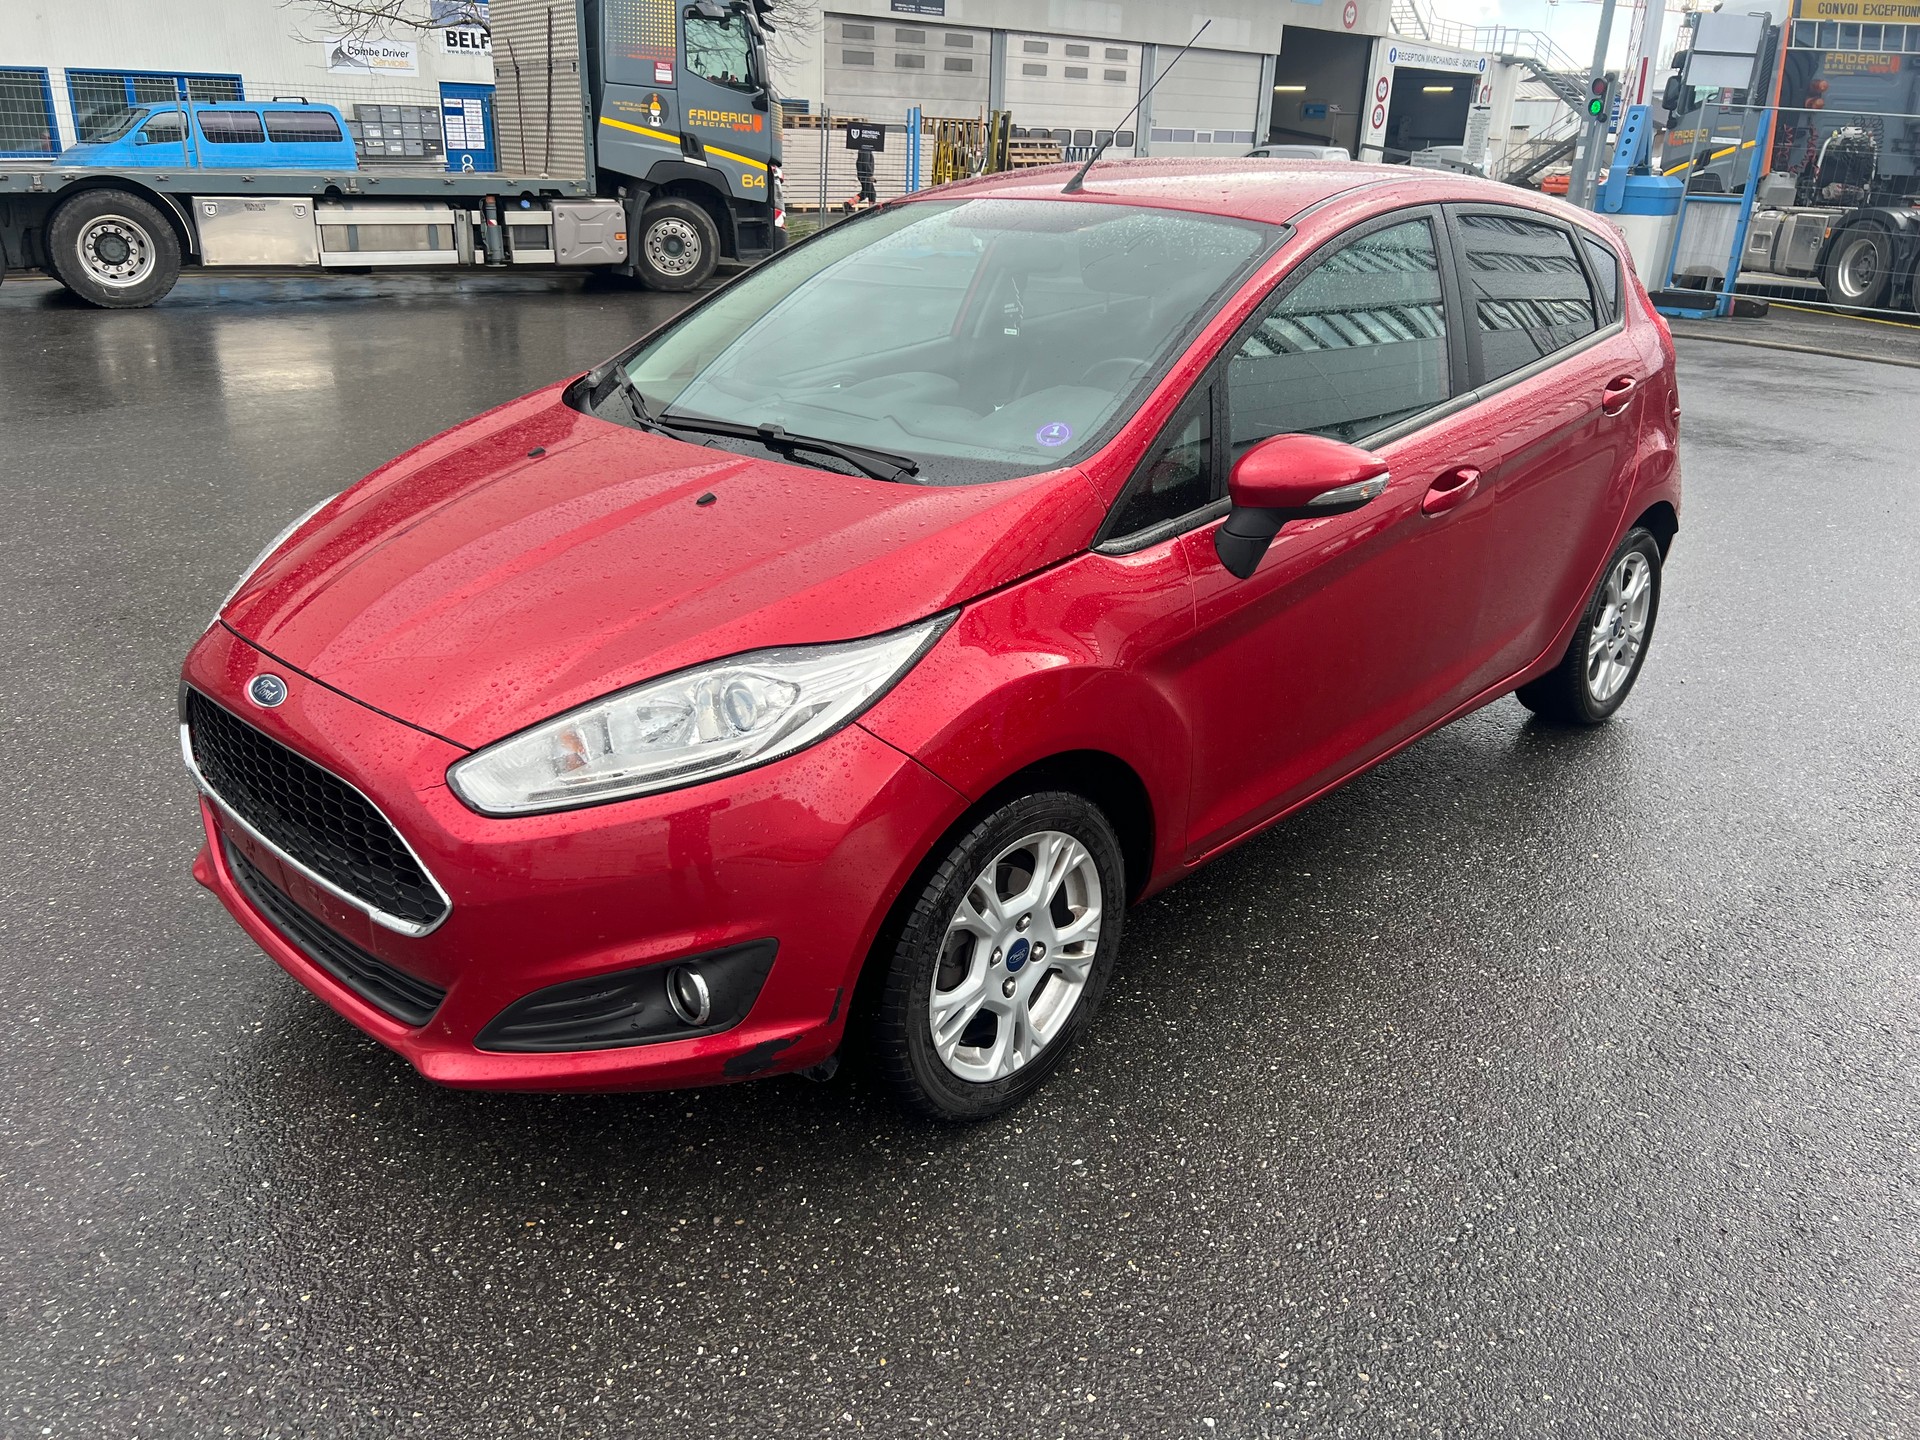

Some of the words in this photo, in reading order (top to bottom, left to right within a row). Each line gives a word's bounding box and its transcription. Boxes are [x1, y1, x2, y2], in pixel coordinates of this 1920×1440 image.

[1818, 2, 1858, 15] CONVOI
[347, 46, 380, 57] Combe
[382, 47, 410, 58] Driver
[372, 56, 409, 68] Services
[1398, 51, 1425, 63] RECEPTION
[1462, 59, 1479, 69] SORTIE
[1825, 52, 1891, 65] FRIDERICI
[1824, 63, 1868, 71] SPECIAL
[688, 108, 753, 125] FRIDERICI
[688, 119, 732, 129] SPECIAL
[1674, 128, 1709, 140] FRIDEICI
[741, 173, 766, 189] 64
[1050, 425, 1060, 436] 1
[253, 679, 279, 701] Ford
